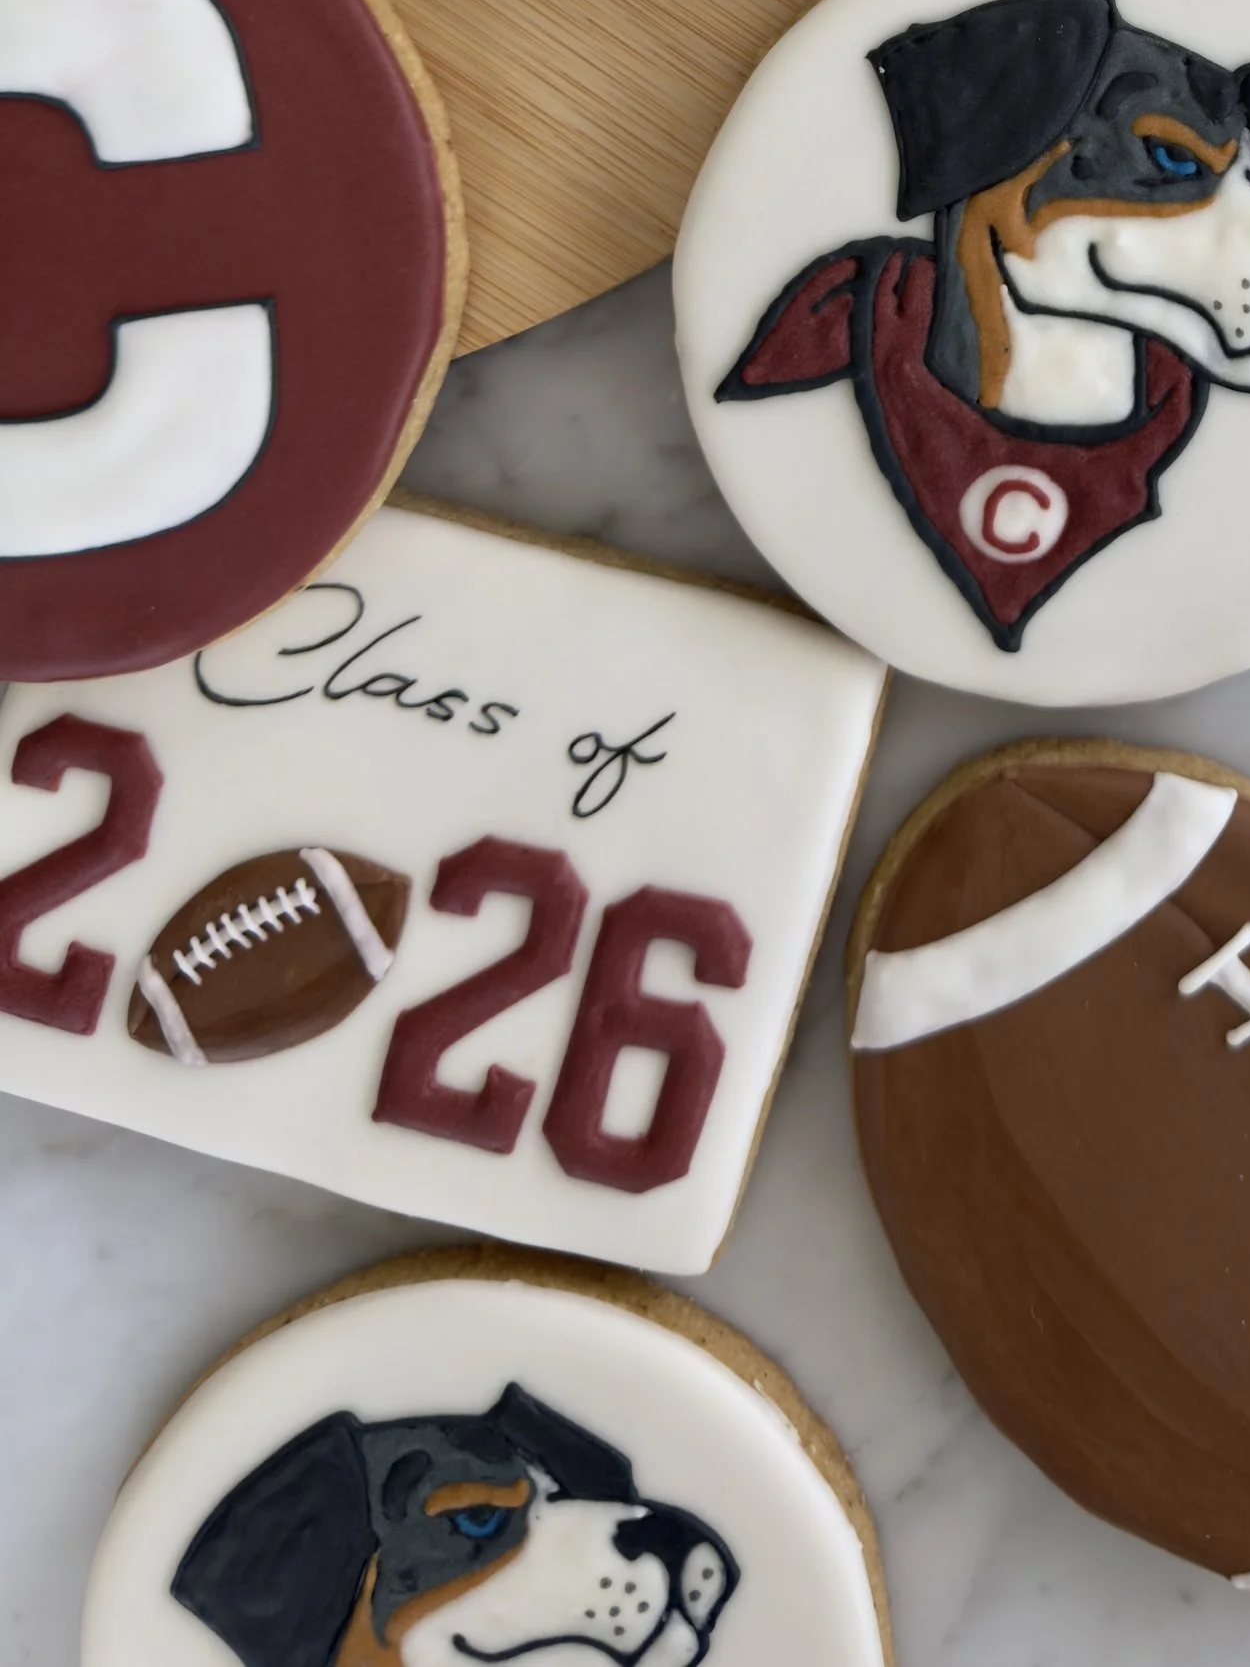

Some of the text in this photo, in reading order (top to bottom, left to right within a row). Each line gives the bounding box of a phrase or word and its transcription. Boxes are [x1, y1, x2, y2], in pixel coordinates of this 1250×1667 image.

[982, 479, 1051, 554] C
[194, 582, 677, 818] Class of
